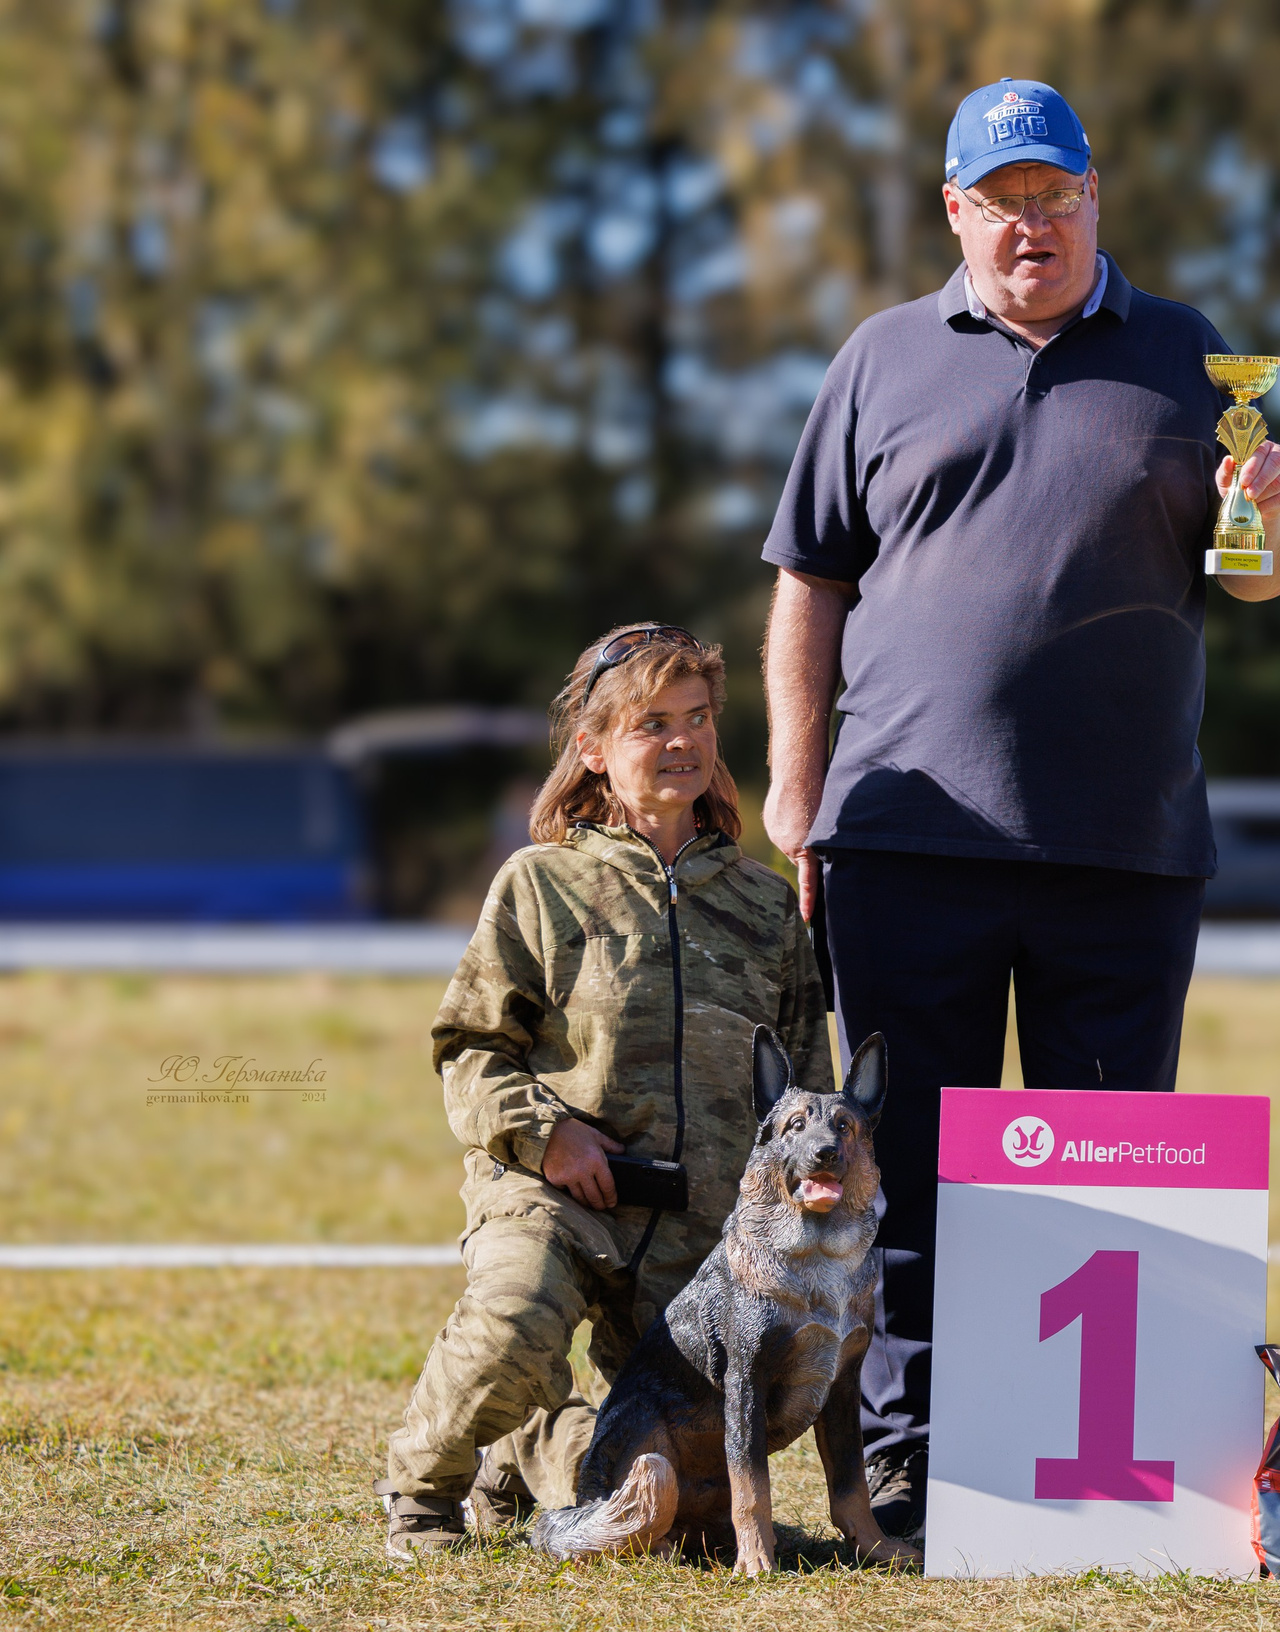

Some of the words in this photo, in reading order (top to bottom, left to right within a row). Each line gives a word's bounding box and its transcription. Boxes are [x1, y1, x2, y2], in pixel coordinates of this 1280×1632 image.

[988, 115, 1048, 145] 1946
[1061, 1140, 1206, 1165] AllerPetfood
[1034, 1250, 1175, 1502] 1
[1261, 1472, 1271, 1488] M/L
